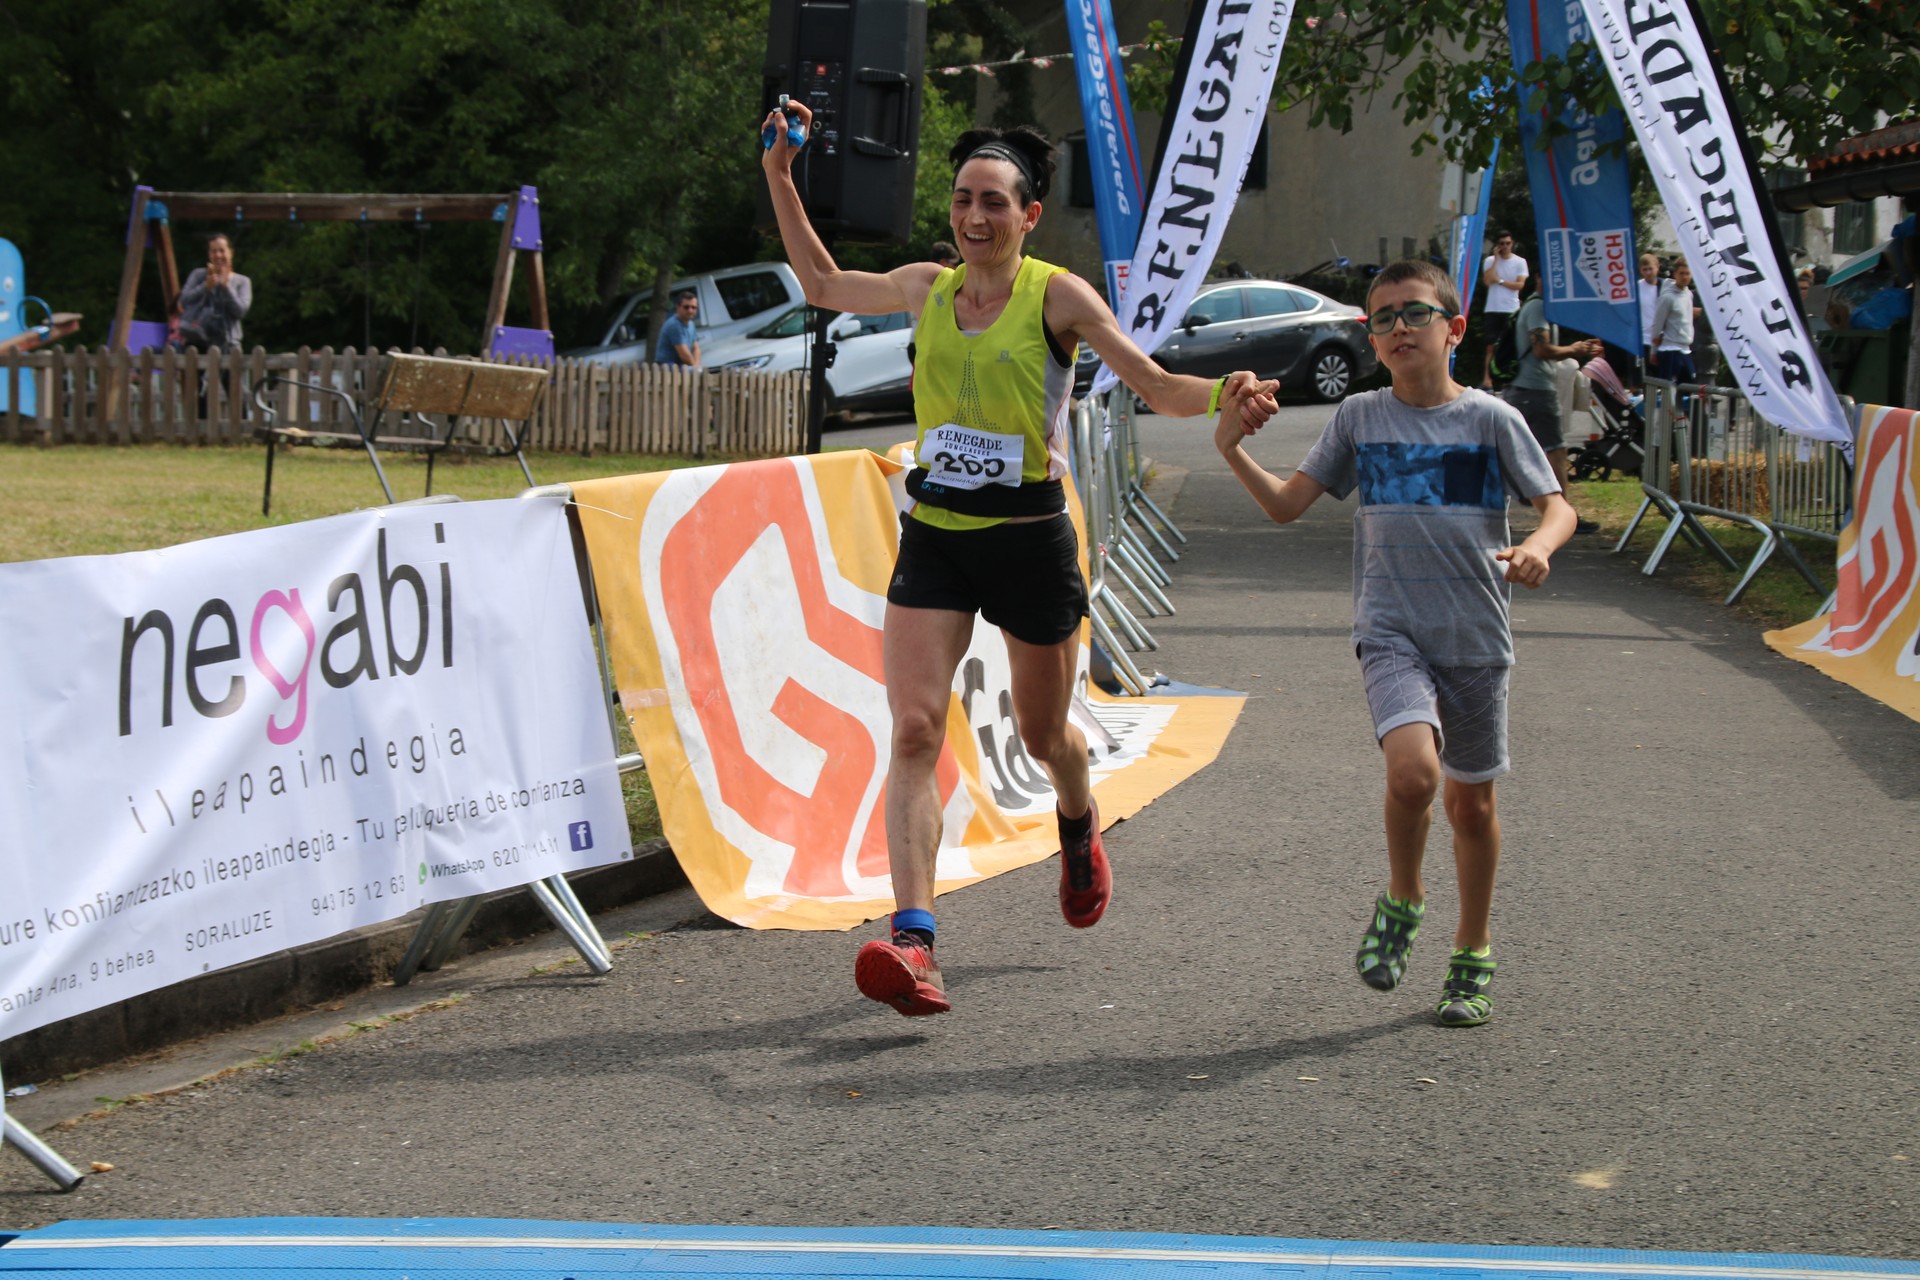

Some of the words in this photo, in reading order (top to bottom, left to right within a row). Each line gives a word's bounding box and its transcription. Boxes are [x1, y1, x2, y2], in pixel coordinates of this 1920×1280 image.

[937, 430, 1002, 450] RENEGADE
[119, 522, 454, 746] negabi
[44, 867, 196, 933] konfiantzazko
[203, 829, 334, 885] ileapaindegia
[356, 818, 384, 843] Tu
[487, 790, 508, 814] de
[511, 778, 586, 809] confianza
[128, 724, 467, 834] ileapaindegia
[1, 984, 43, 1012] anta
[49, 973, 83, 995] Ana,
[90, 961, 99, 982] 9
[106, 949, 155, 977] behea
[185, 910, 274, 951] SORALUZE
[338, 887, 356, 908] 75
[364, 880, 383, 902] 12
[430, 858, 485, 879] WhatsApp
[493, 846, 520, 867] 620
